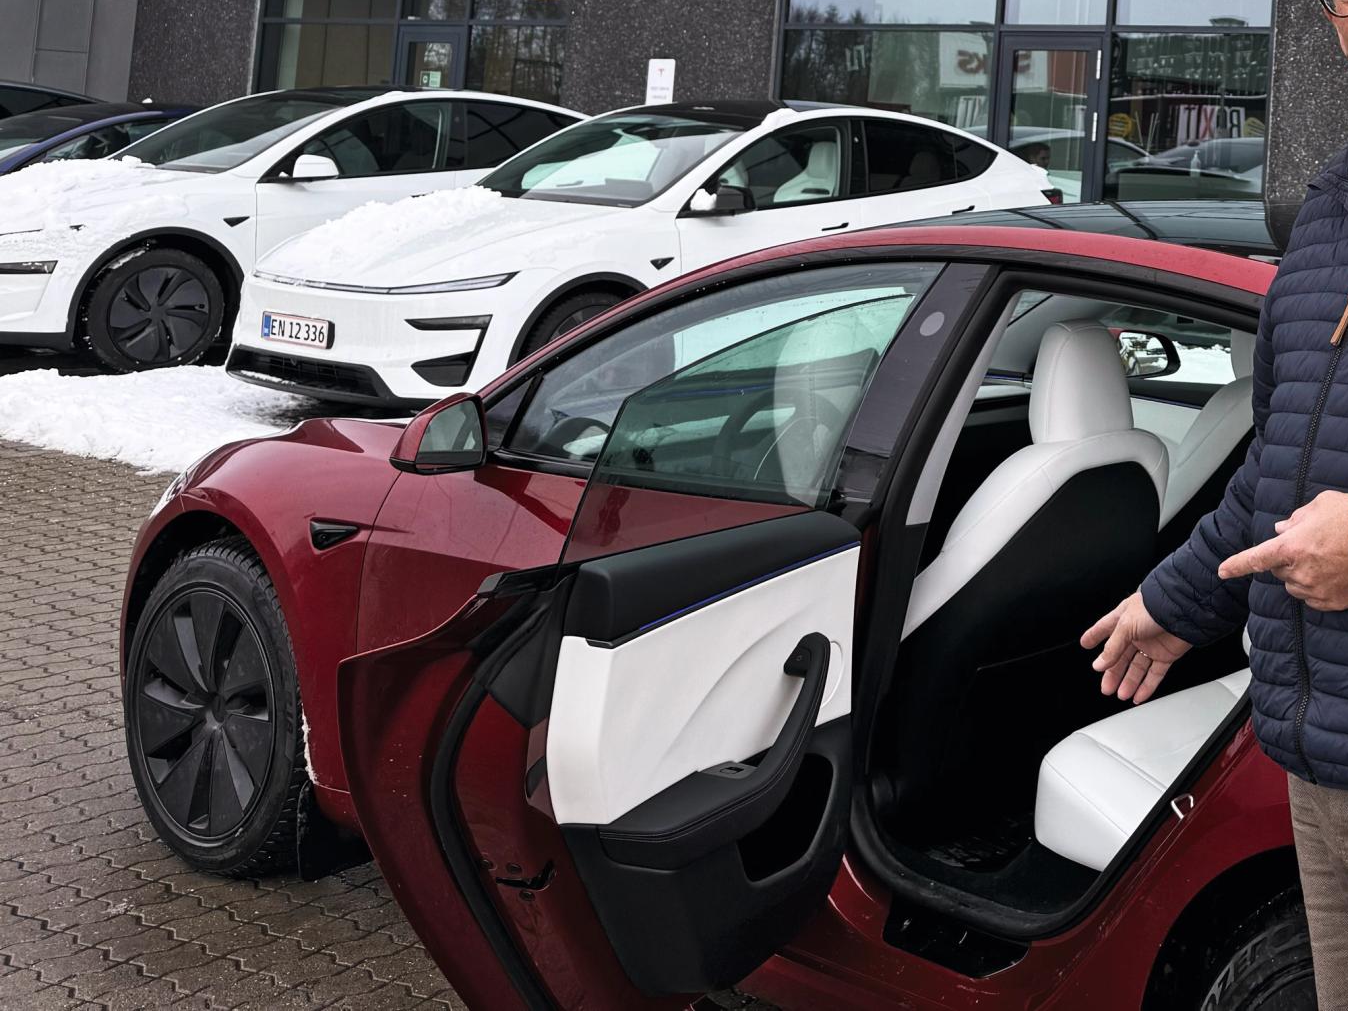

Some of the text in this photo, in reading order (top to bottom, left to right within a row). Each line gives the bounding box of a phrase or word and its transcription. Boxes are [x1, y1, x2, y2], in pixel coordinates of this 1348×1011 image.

[270, 319, 325, 343] EN 12 336
